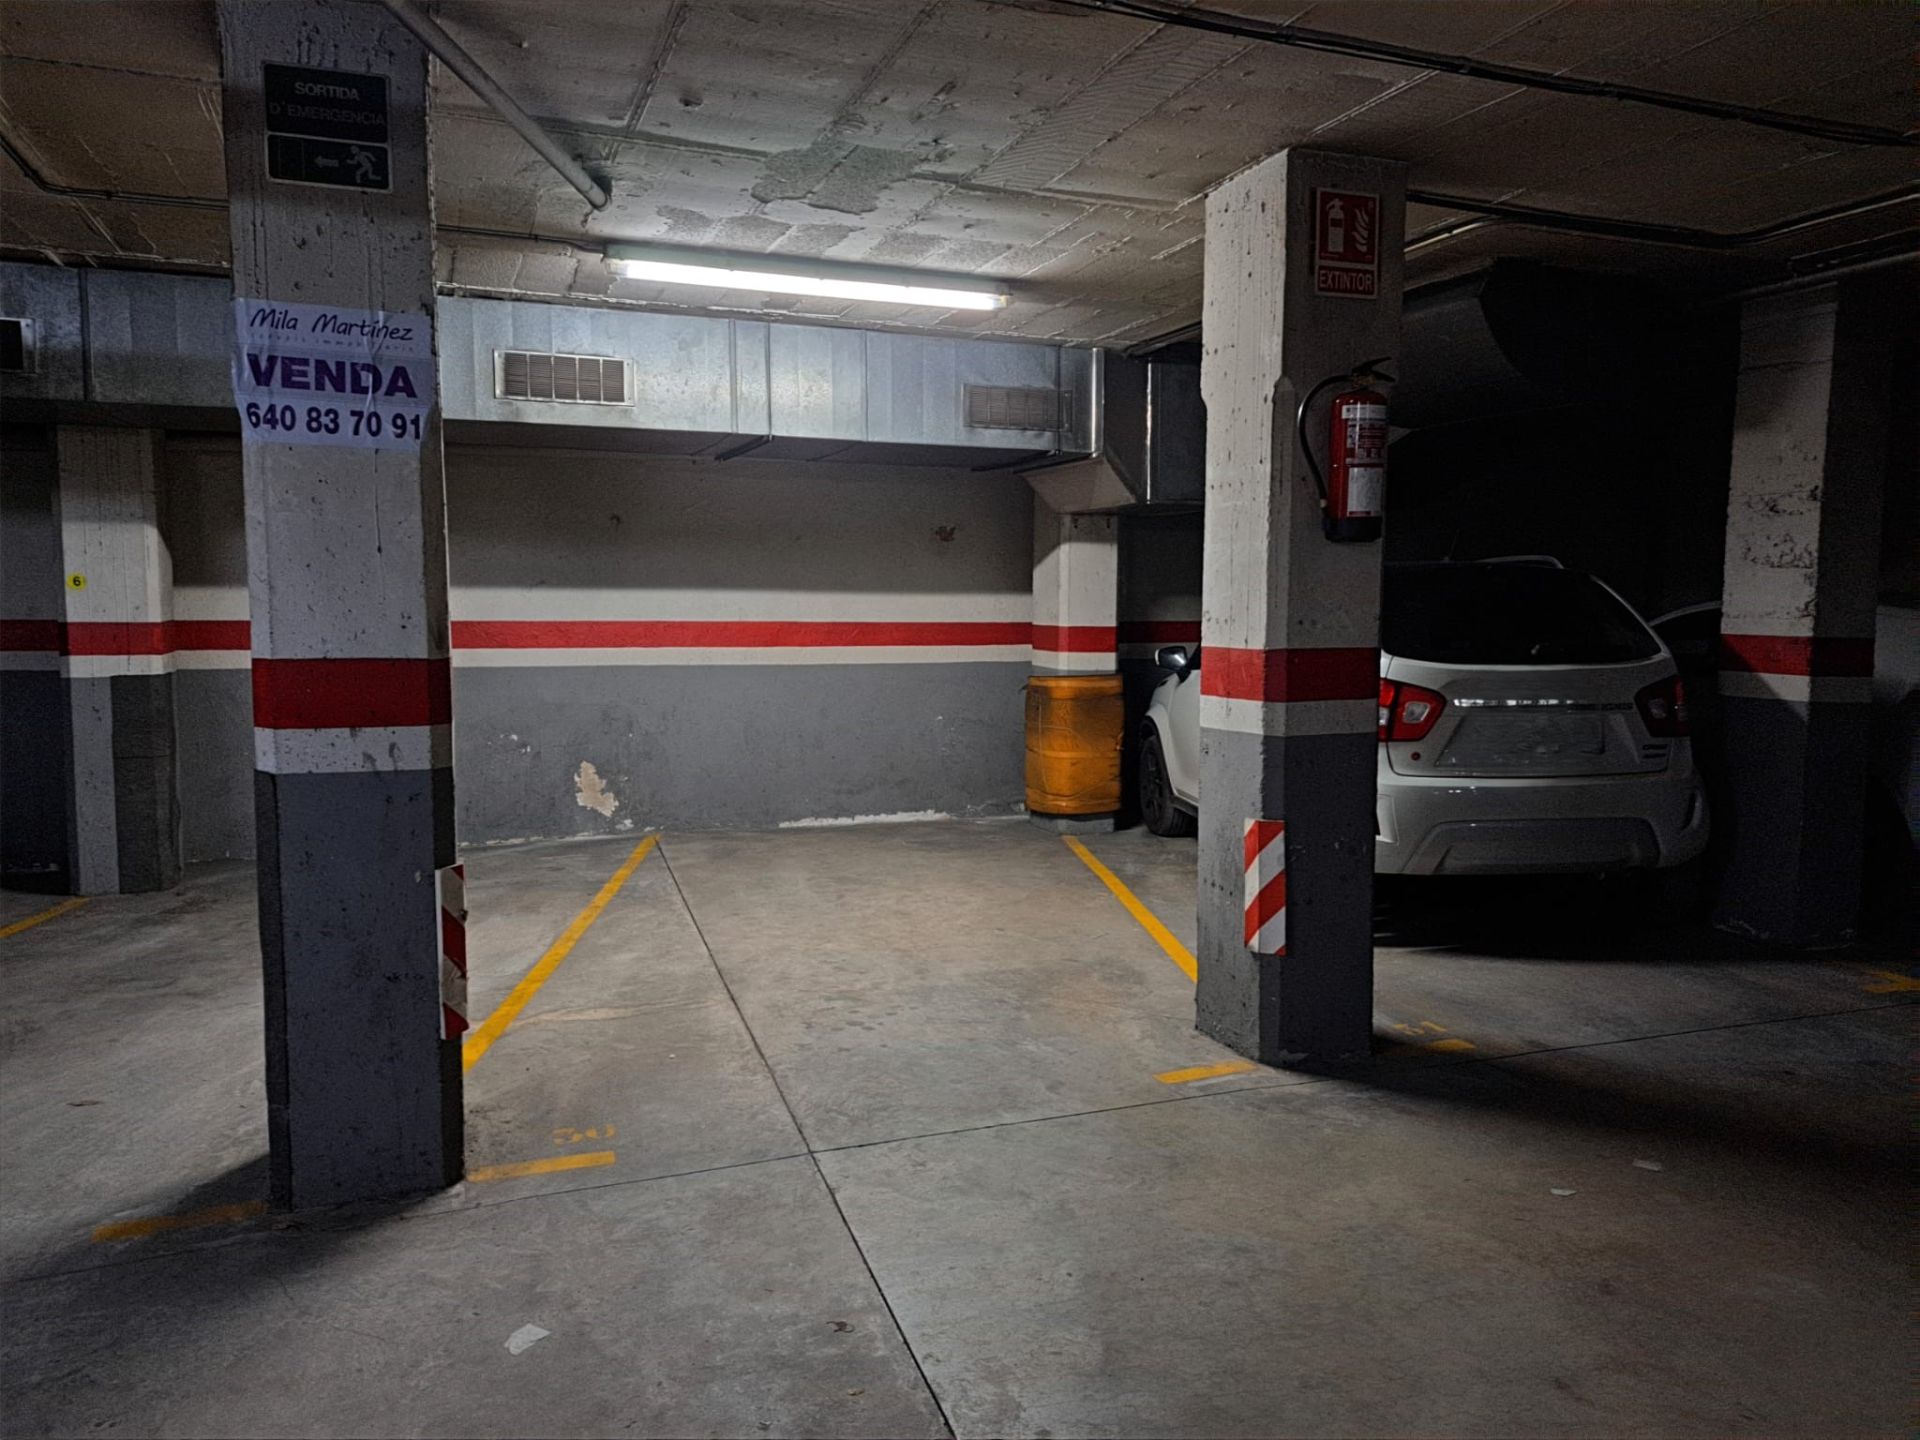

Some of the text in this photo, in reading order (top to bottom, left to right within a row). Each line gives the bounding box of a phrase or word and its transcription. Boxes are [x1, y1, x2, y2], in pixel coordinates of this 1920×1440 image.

[294, 81, 360, 101] SORTIDA
[1319, 269, 1374, 293] EXTINTOR
[250, 308, 299, 331] Mila
[247, 353, 418, 399] VENDA
[246, 402, 421, 441] 640 83 70 91
[73, 575, 82, 587] 6
